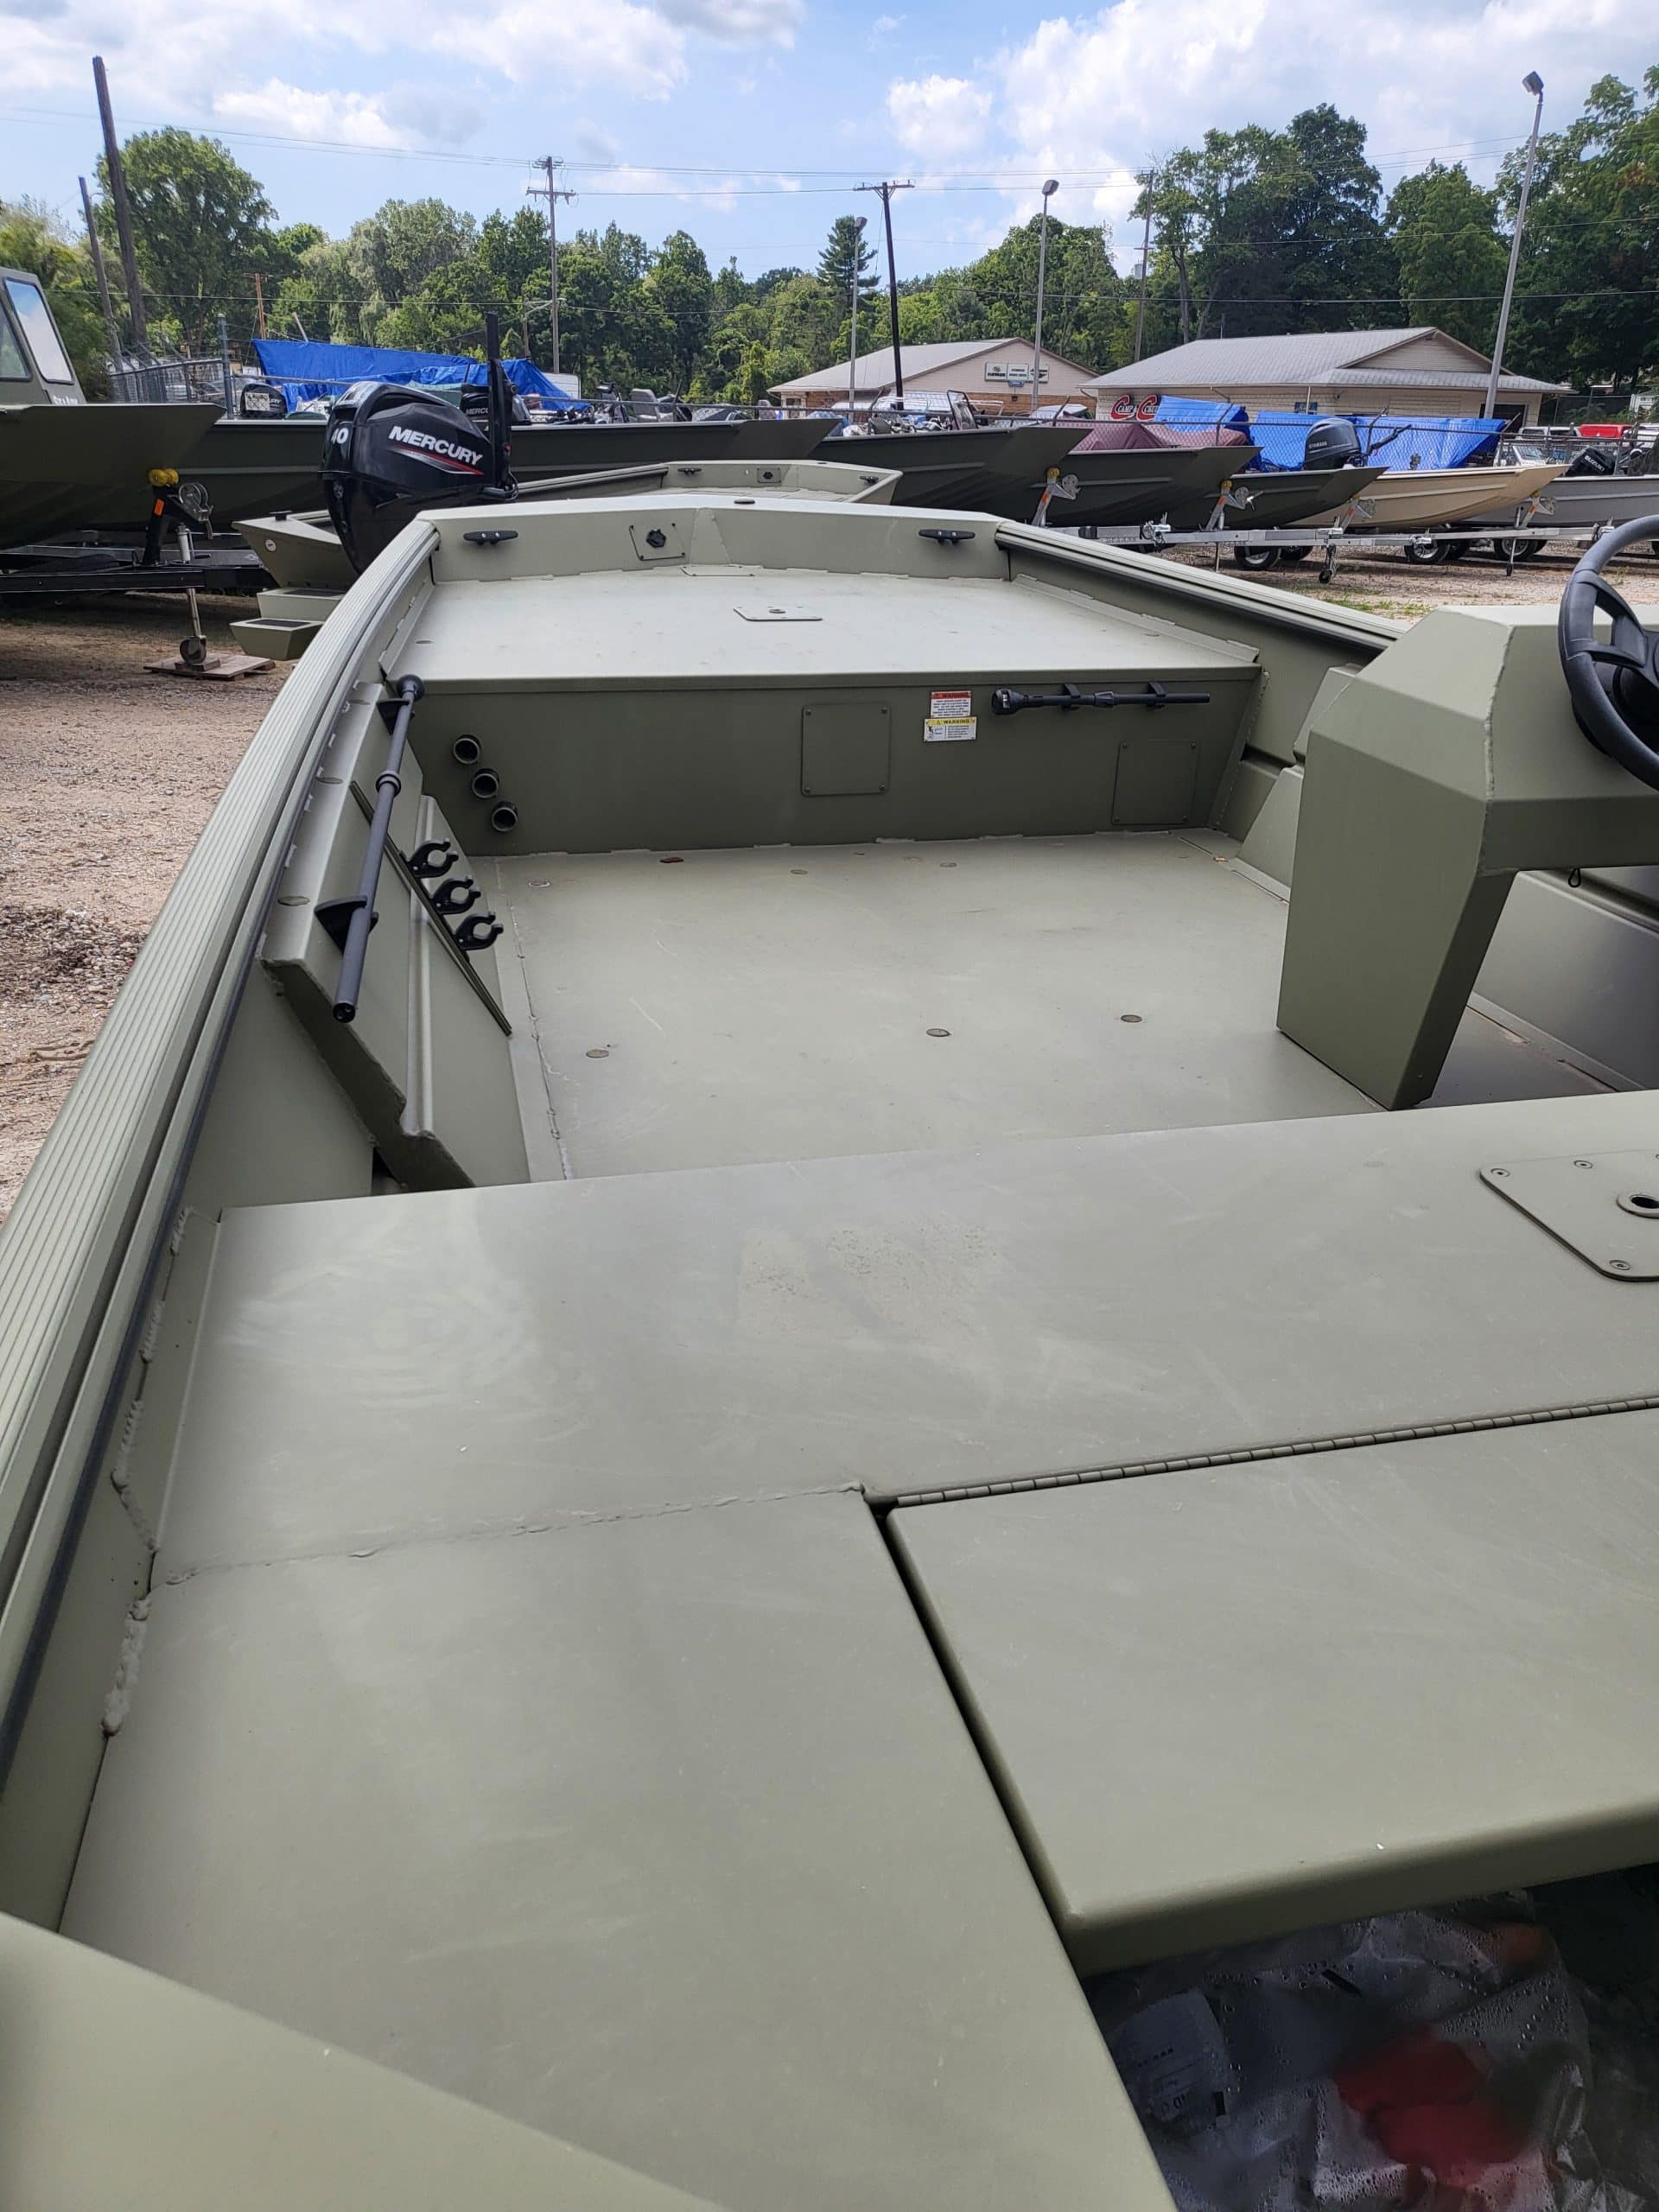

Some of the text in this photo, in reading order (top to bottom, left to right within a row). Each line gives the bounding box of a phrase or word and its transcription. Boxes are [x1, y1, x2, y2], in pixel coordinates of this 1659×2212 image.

[465, 407, 489, 416] MERC
[331, 428, 349, 444] 40
[389, 426, 484, 466] MERCURY
[1584, 454, 1605, 472] SUZUKI
